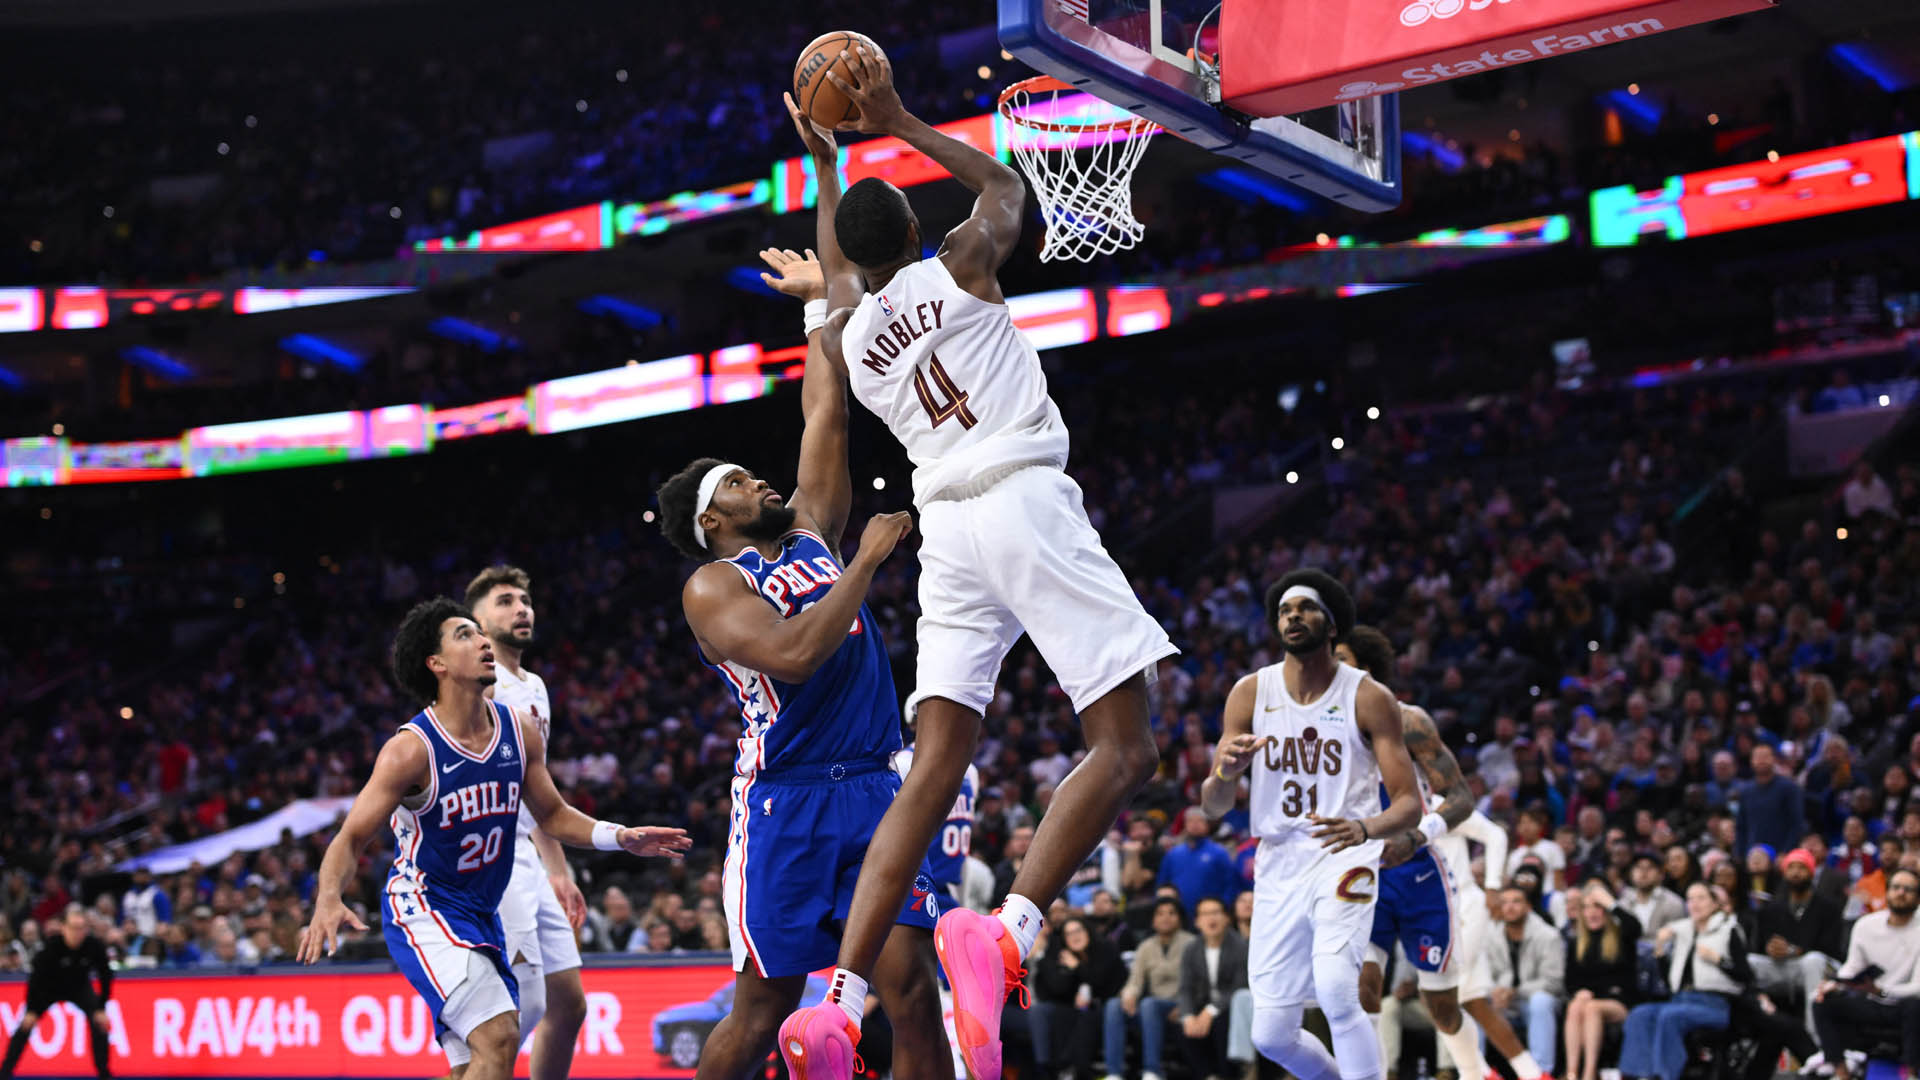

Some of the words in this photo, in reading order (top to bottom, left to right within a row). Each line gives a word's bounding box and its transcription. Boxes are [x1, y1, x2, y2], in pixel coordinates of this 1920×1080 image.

[797, 52, 828, 98] Wilso
[862, 300, 944, 376] MOBLEY
[914, 351, 979, 431] 4
[761, 556, 843, 619] PHILA
[1264, 735, 1342, 776] CAVS
[439, 780, 521, 829] PHILA
[1282, 780, 1318, 818] 31
[457, 826, 503, 872] 20
[911, 888, 937, 919] 76
[1419, 944, 1443, 966] 76
[0, 999, 131, 1058] YOTA
[153, 996, 320, 1057] RAV4th
